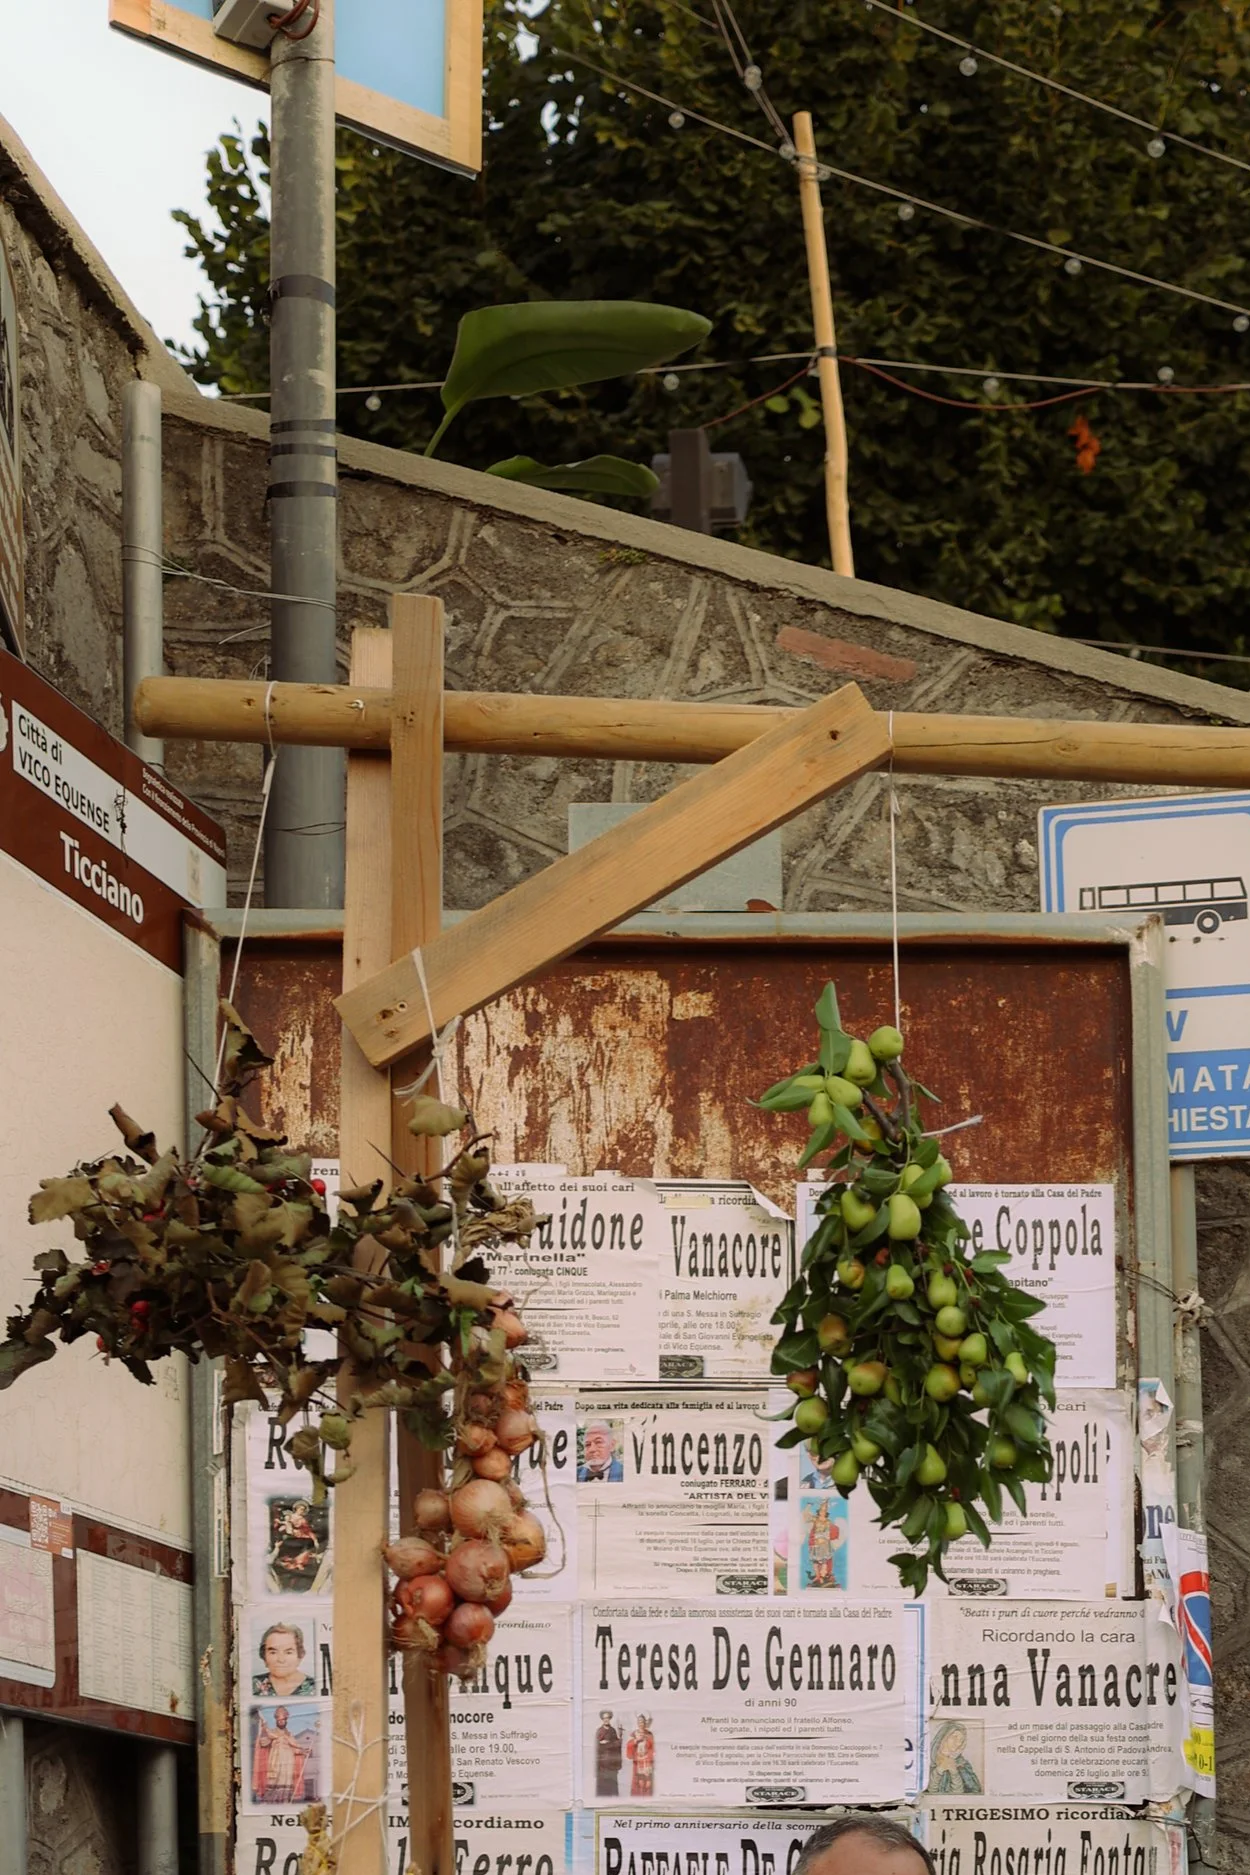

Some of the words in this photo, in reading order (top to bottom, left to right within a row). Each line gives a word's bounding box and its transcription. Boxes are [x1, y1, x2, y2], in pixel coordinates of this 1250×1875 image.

[19, 715, 47, 753] Città
[51, 740, 62, 765] di
[19, 747, 50, 788] VICO
[55, 775, 109, 833] EQUENSE
[60, 831, 144, 924] Ticciano
[560, 1183, 577, 1192] dei
[582, 1183, 607, 1192] suoi
[612, 1183, 634, 1192] cari
[960, 1189, 966, 1197] al
[969, 1189, 991, 1198] lavoro
[1001, 1190, 1029, 1198] tornato
[1031, 1189, 1044, 1197] alla
[1047, 1190, 1064, 1198] Casa
[1067, 1189, 1078, 1197] del
[1081, 1190, 1102, 1198] Padre
[719, 1195, 759, 1205] ricordia
[539, 1197, 643, 1250] uidone
[997, 1204, 1102, 1270] Coppola
[671, 1216, 781, 1279] Vanacore
[498, 1267, 507, 1275] 77
[557, 1268, 588, 1276] CINQUE
[665, 1291, 690, 1300] Palma
[693, 1291, 737, 1301] Melchiorre
[575, 1402, 595, 1412] Dopo
[682, 1402, 712, 1411] famiglia
[735, 1402, 759, 1410] lavoro
[1057, 1402, 1086, 1411] cari
[630, 1415, 762, 1475] Vincenzo
[1041, 1422, 1098, 1501] poli
[681, 1480, 718, 1488] coniugato
[720, 1479, 756, 1488] FERRARO
[998, 1608, 1018, 1620] puri
[1021, 1608, 1030, 1618] di
[1032, 1610, 1058, 1618] cuore
[1061, 1607, 1091, 1620] perché
[1094, 1608, 1137, 1618] vedranno
[982, 1629, 1075, 1643] Ricordando
[1081, 1629, 1094, 1643] la
[1101, 1632, 1135, 1643] cara
[595, 1624, 697, 1691] Teresa
[712, 1626, 750, 1691] De
[766, 1625, 895, 1691] Gennaro
[930, 1663, 1010, 1706] nna
[745, 1698, 755, 1707] di
[758, 1698, 781, 1707] anni
[785, 1698, 797, 1707] 90
[462, 1732, 488, 1740] Messa
[500, 1731, 538, 1740] Suffragio
[997, 1746, 1015, 1754] nella
[1018, 1746, 1053, 1756] Cappella
[1056, 1746, 1063, 1754] di
[1075, 1746, 1105, 1754] Antonio
[1108, 1746, 1115, 1754] di
[1035, 1769, 1073, 1778] domenica
[1076, 1769, 1085, 1778] 26
[1087, 1769, 1110, 1780] luglio
[1112, 1770, 1125, 1778] alle
[1127, 1770, 1140, 1778] ore
[942, 1808, 1049, 1821] TRIGESIMO
[613, 1820, 632, 1829] Nel
[635, 1820, 671, 1830] primo
[674, 1821, 749, 1830] anniversario
[753, 1821, 782, 1830] della
